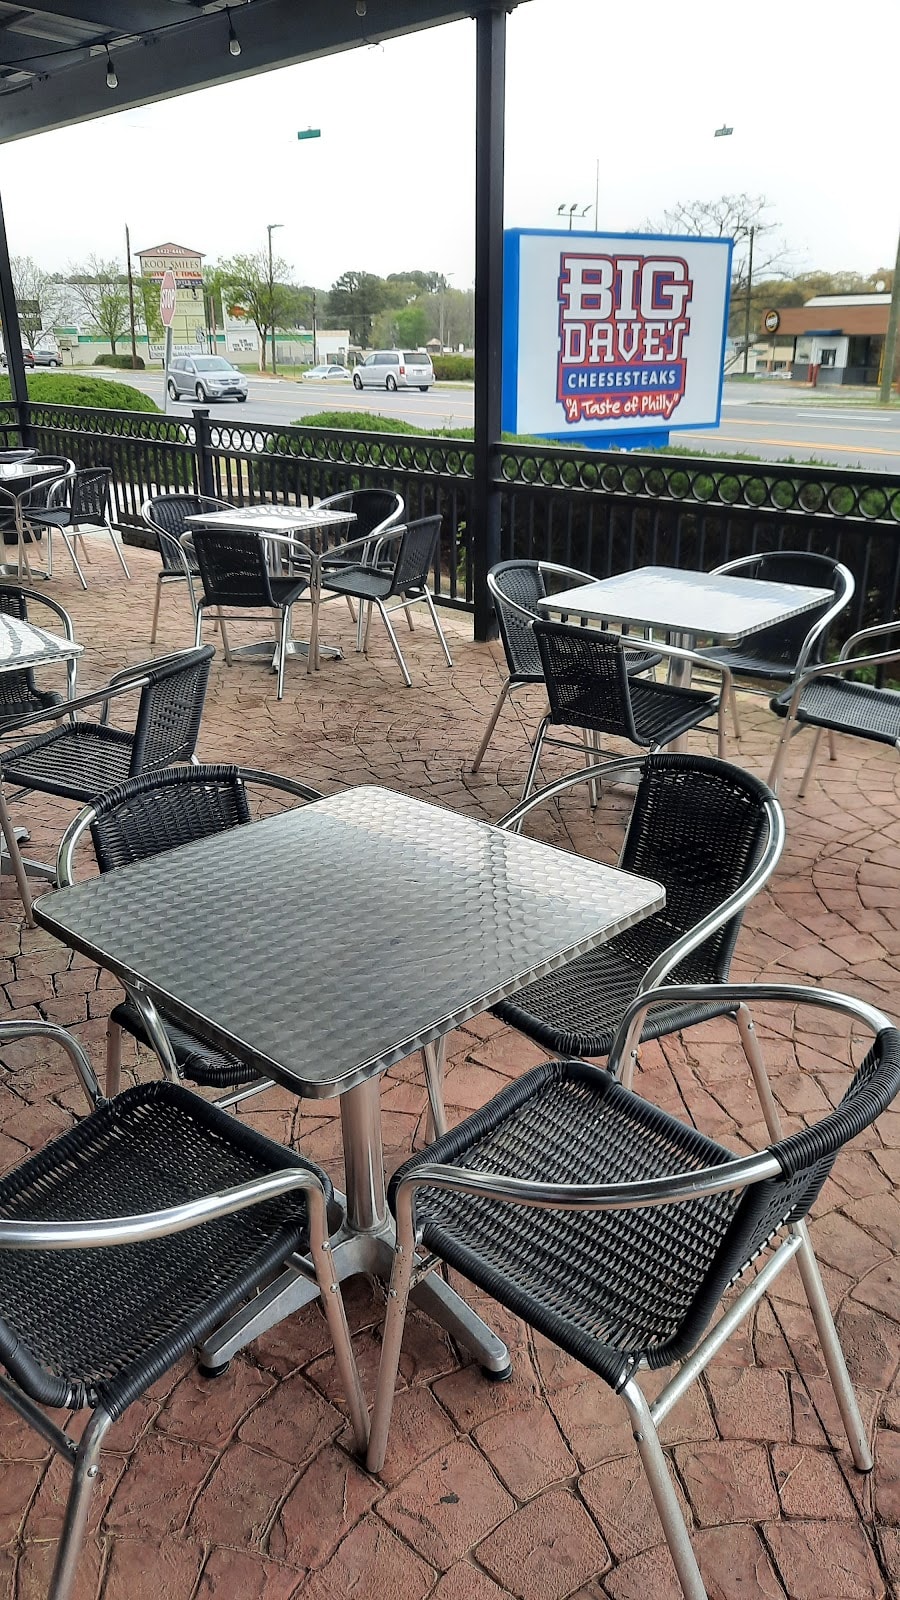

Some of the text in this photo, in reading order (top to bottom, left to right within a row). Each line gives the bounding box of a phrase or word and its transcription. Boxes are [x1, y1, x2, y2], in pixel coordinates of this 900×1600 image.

[144, 260, 199, 269] KOOL SMILES
[161, 288, 176, 309] STOP
[561, 257, 689, 320] BIG
[561, 320, 687, 364] DAVE'S
[567, 369, 676, 389] CHEESESTEAKS
[565, 392, 680, 419] "A Taste of Philly"
